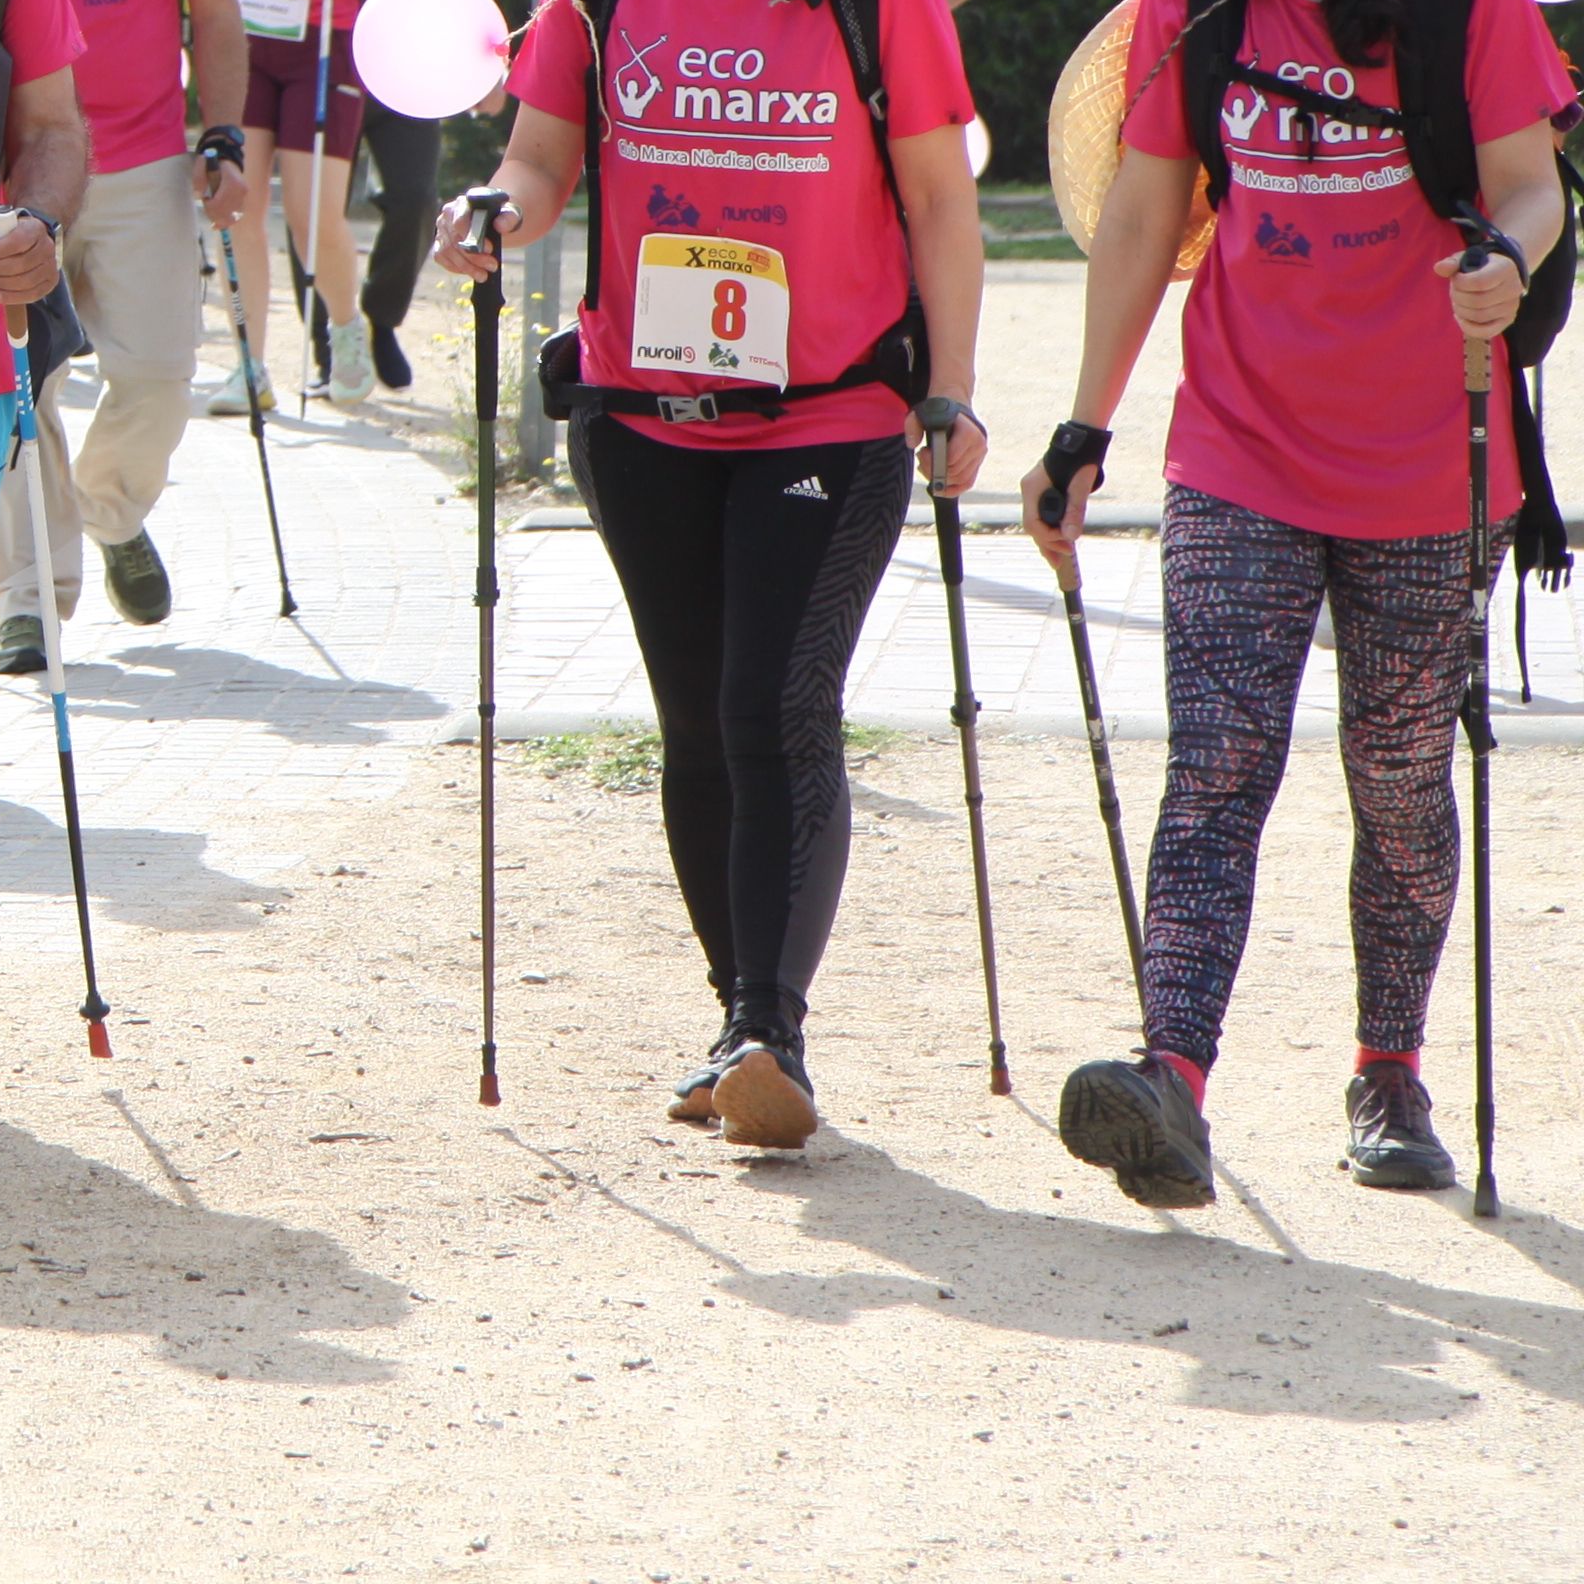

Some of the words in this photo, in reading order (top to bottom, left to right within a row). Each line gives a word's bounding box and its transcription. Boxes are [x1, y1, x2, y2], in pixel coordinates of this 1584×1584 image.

[678, 47, 764, 80] eco
[675, 86, 838, 124] marxa
[640, 143, 689, 164] Marxa
[693, 149, 752, 169] Nòrdica
[755, 154, 830, 172] Collserola
[1247, 171, 1297, 191] Marxa
[1299, 175, 1361, 193] Nòrdica
[723, 205, 771, 223] nuroil
[685, 246, 706, 268] X
[708, 248, 737, 259] eco
[708, 259, 752, 273] marxa
[712, 279, 747, 340] 8
[637, 346, 681, 361] nuroil
[783, 487, 828, 500] adidas
